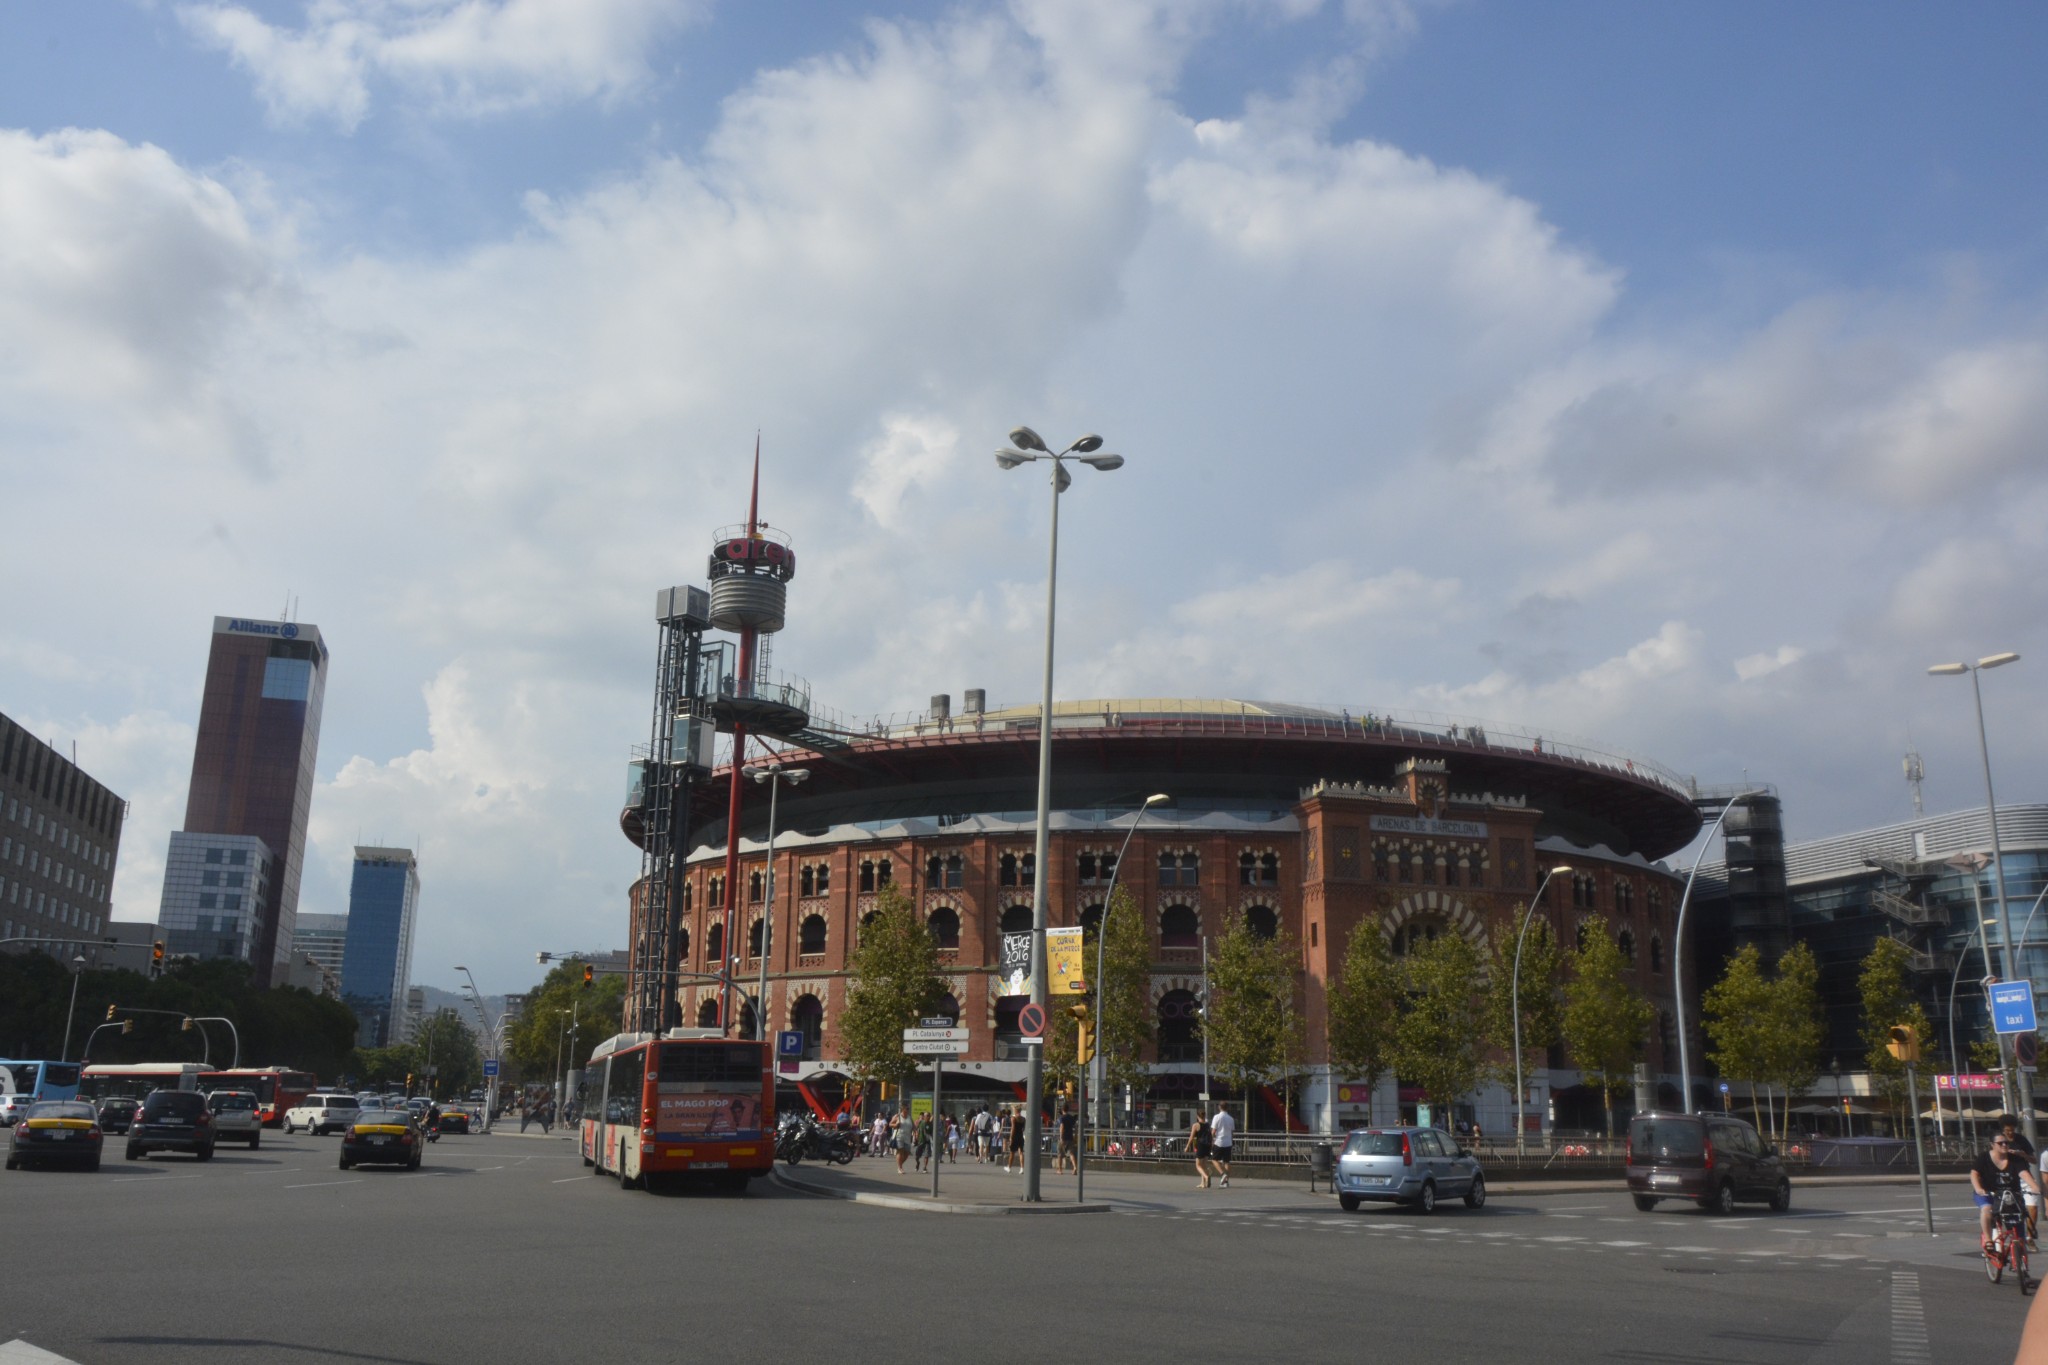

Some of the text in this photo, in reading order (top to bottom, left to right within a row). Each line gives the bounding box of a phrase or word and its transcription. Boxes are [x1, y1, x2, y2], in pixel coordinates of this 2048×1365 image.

[228, 619, 280, 635] Allianz
[1377, 819, 1480, 835] ARENAS DE BARCELONA
[1006, 948, 1029, 964] 2016
[2006, 1014, 2024, 1025] taxi
[920, 1030, 945, 1038] Catalunya
[785, 1035, 798, 1050] P
[675, 1100, 706, 1108] MAGO
[708, 1099, 729, 1107] POP
